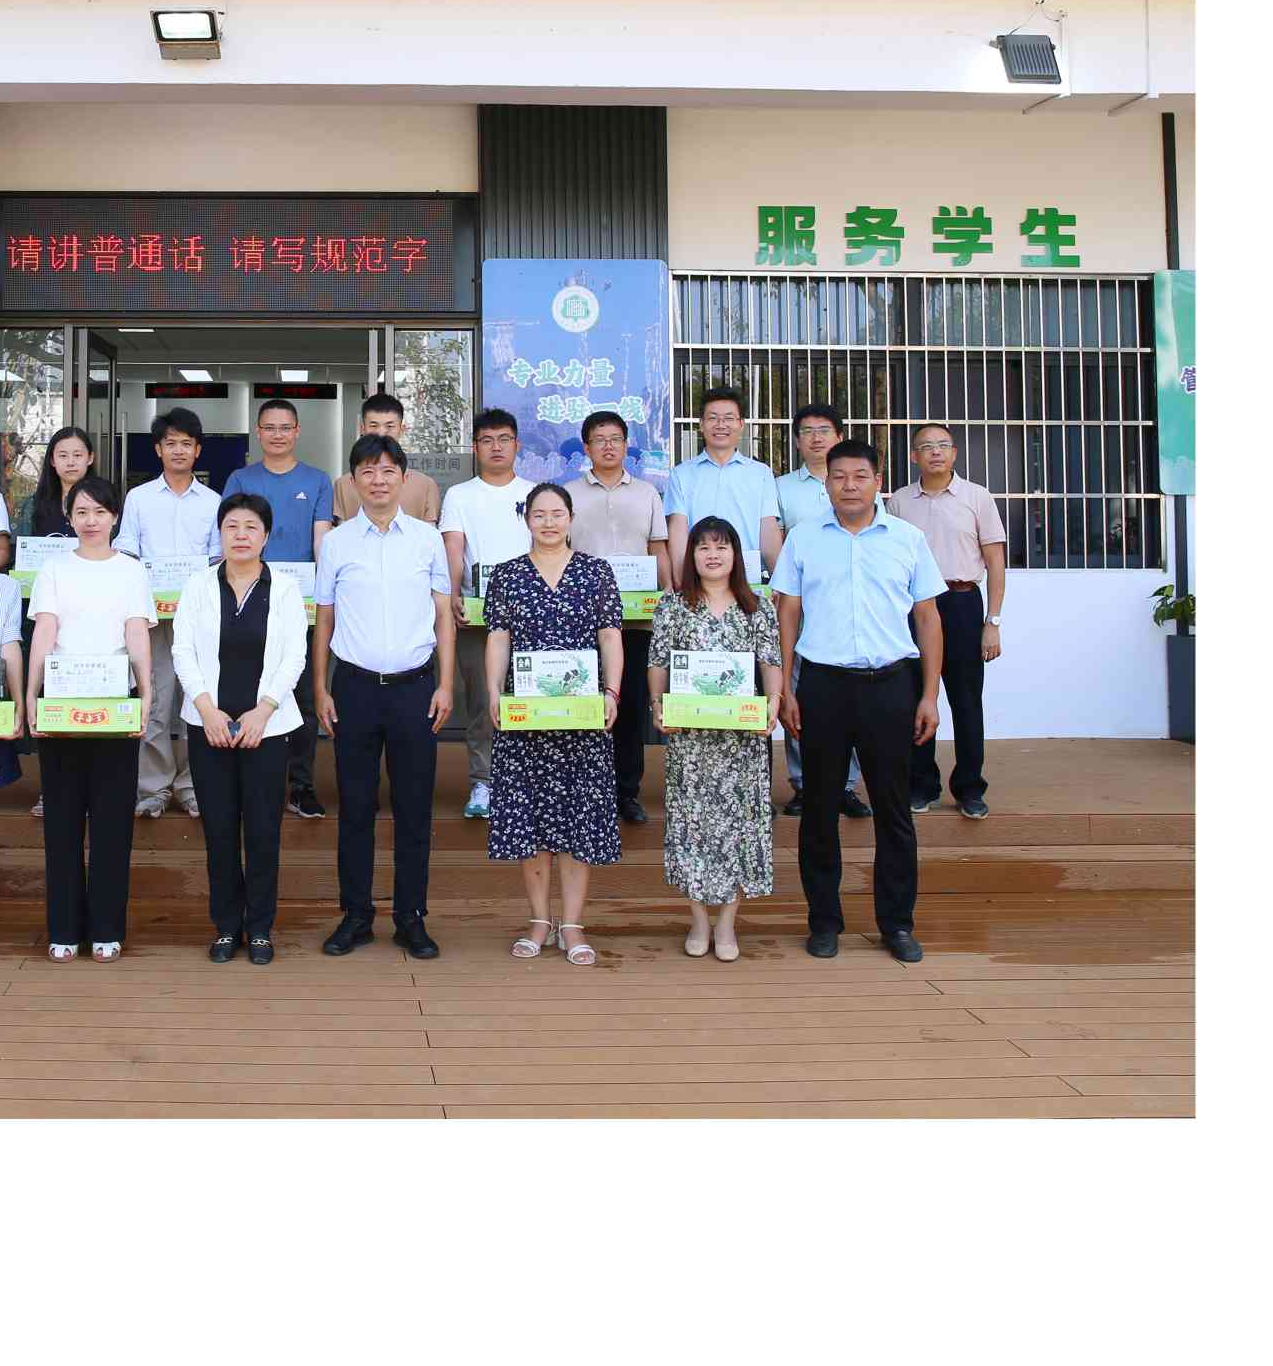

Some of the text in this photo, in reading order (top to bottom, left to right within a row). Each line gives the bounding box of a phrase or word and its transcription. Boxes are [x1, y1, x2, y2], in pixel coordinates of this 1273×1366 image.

[6, 233, 430, 274] 请讲普通话 请写规范字
[755, 204, 1082, 268] 服务学生
[507, 357, 615, 389] 专业力量
[407, 456, 461, 470] 工作时间
